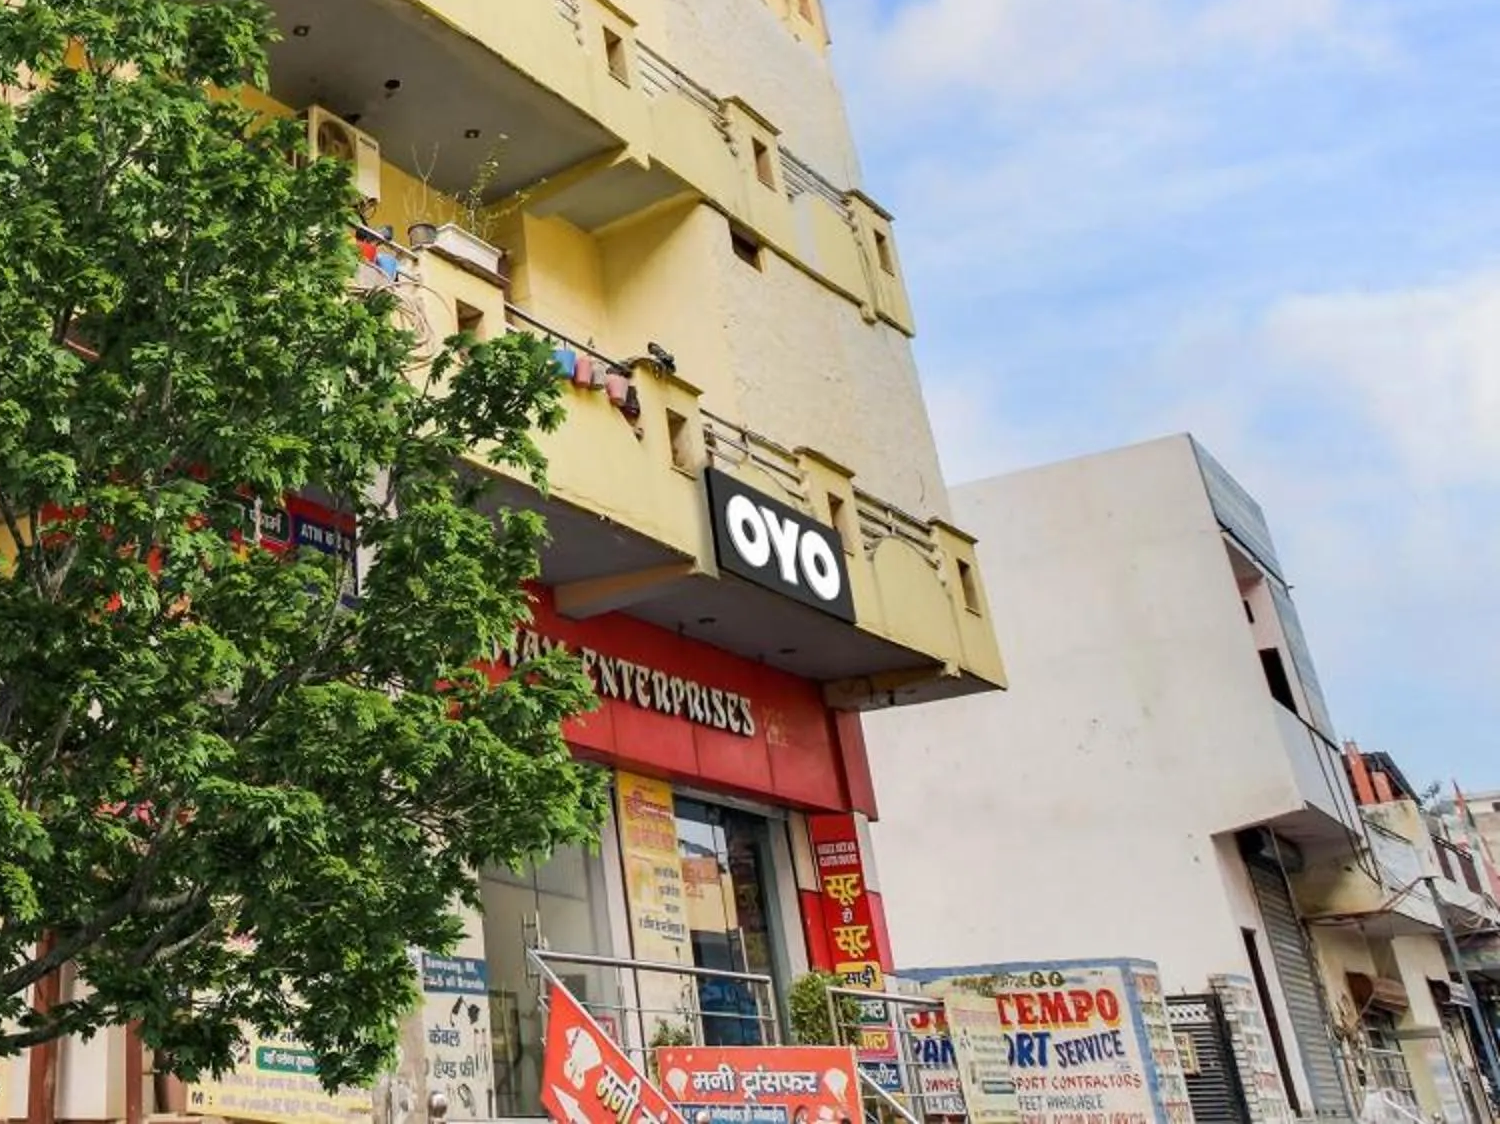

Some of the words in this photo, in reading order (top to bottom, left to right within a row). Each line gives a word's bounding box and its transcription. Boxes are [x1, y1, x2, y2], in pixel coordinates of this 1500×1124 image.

[725, 493, 842, 602] OYO
[580, 646, 756, 738] ENTERPRISES
[823, 873, 861, 907] सूट
[832, 925, 871, 959] सूट
[996, 987, 1119, 1027] TEMPO
[1055, 1029, 1125, 1069] SERVICE
[692, 1063, 736, 1093] मनी
[1052, 1073, 1142, 1090] CONTRACTORS
